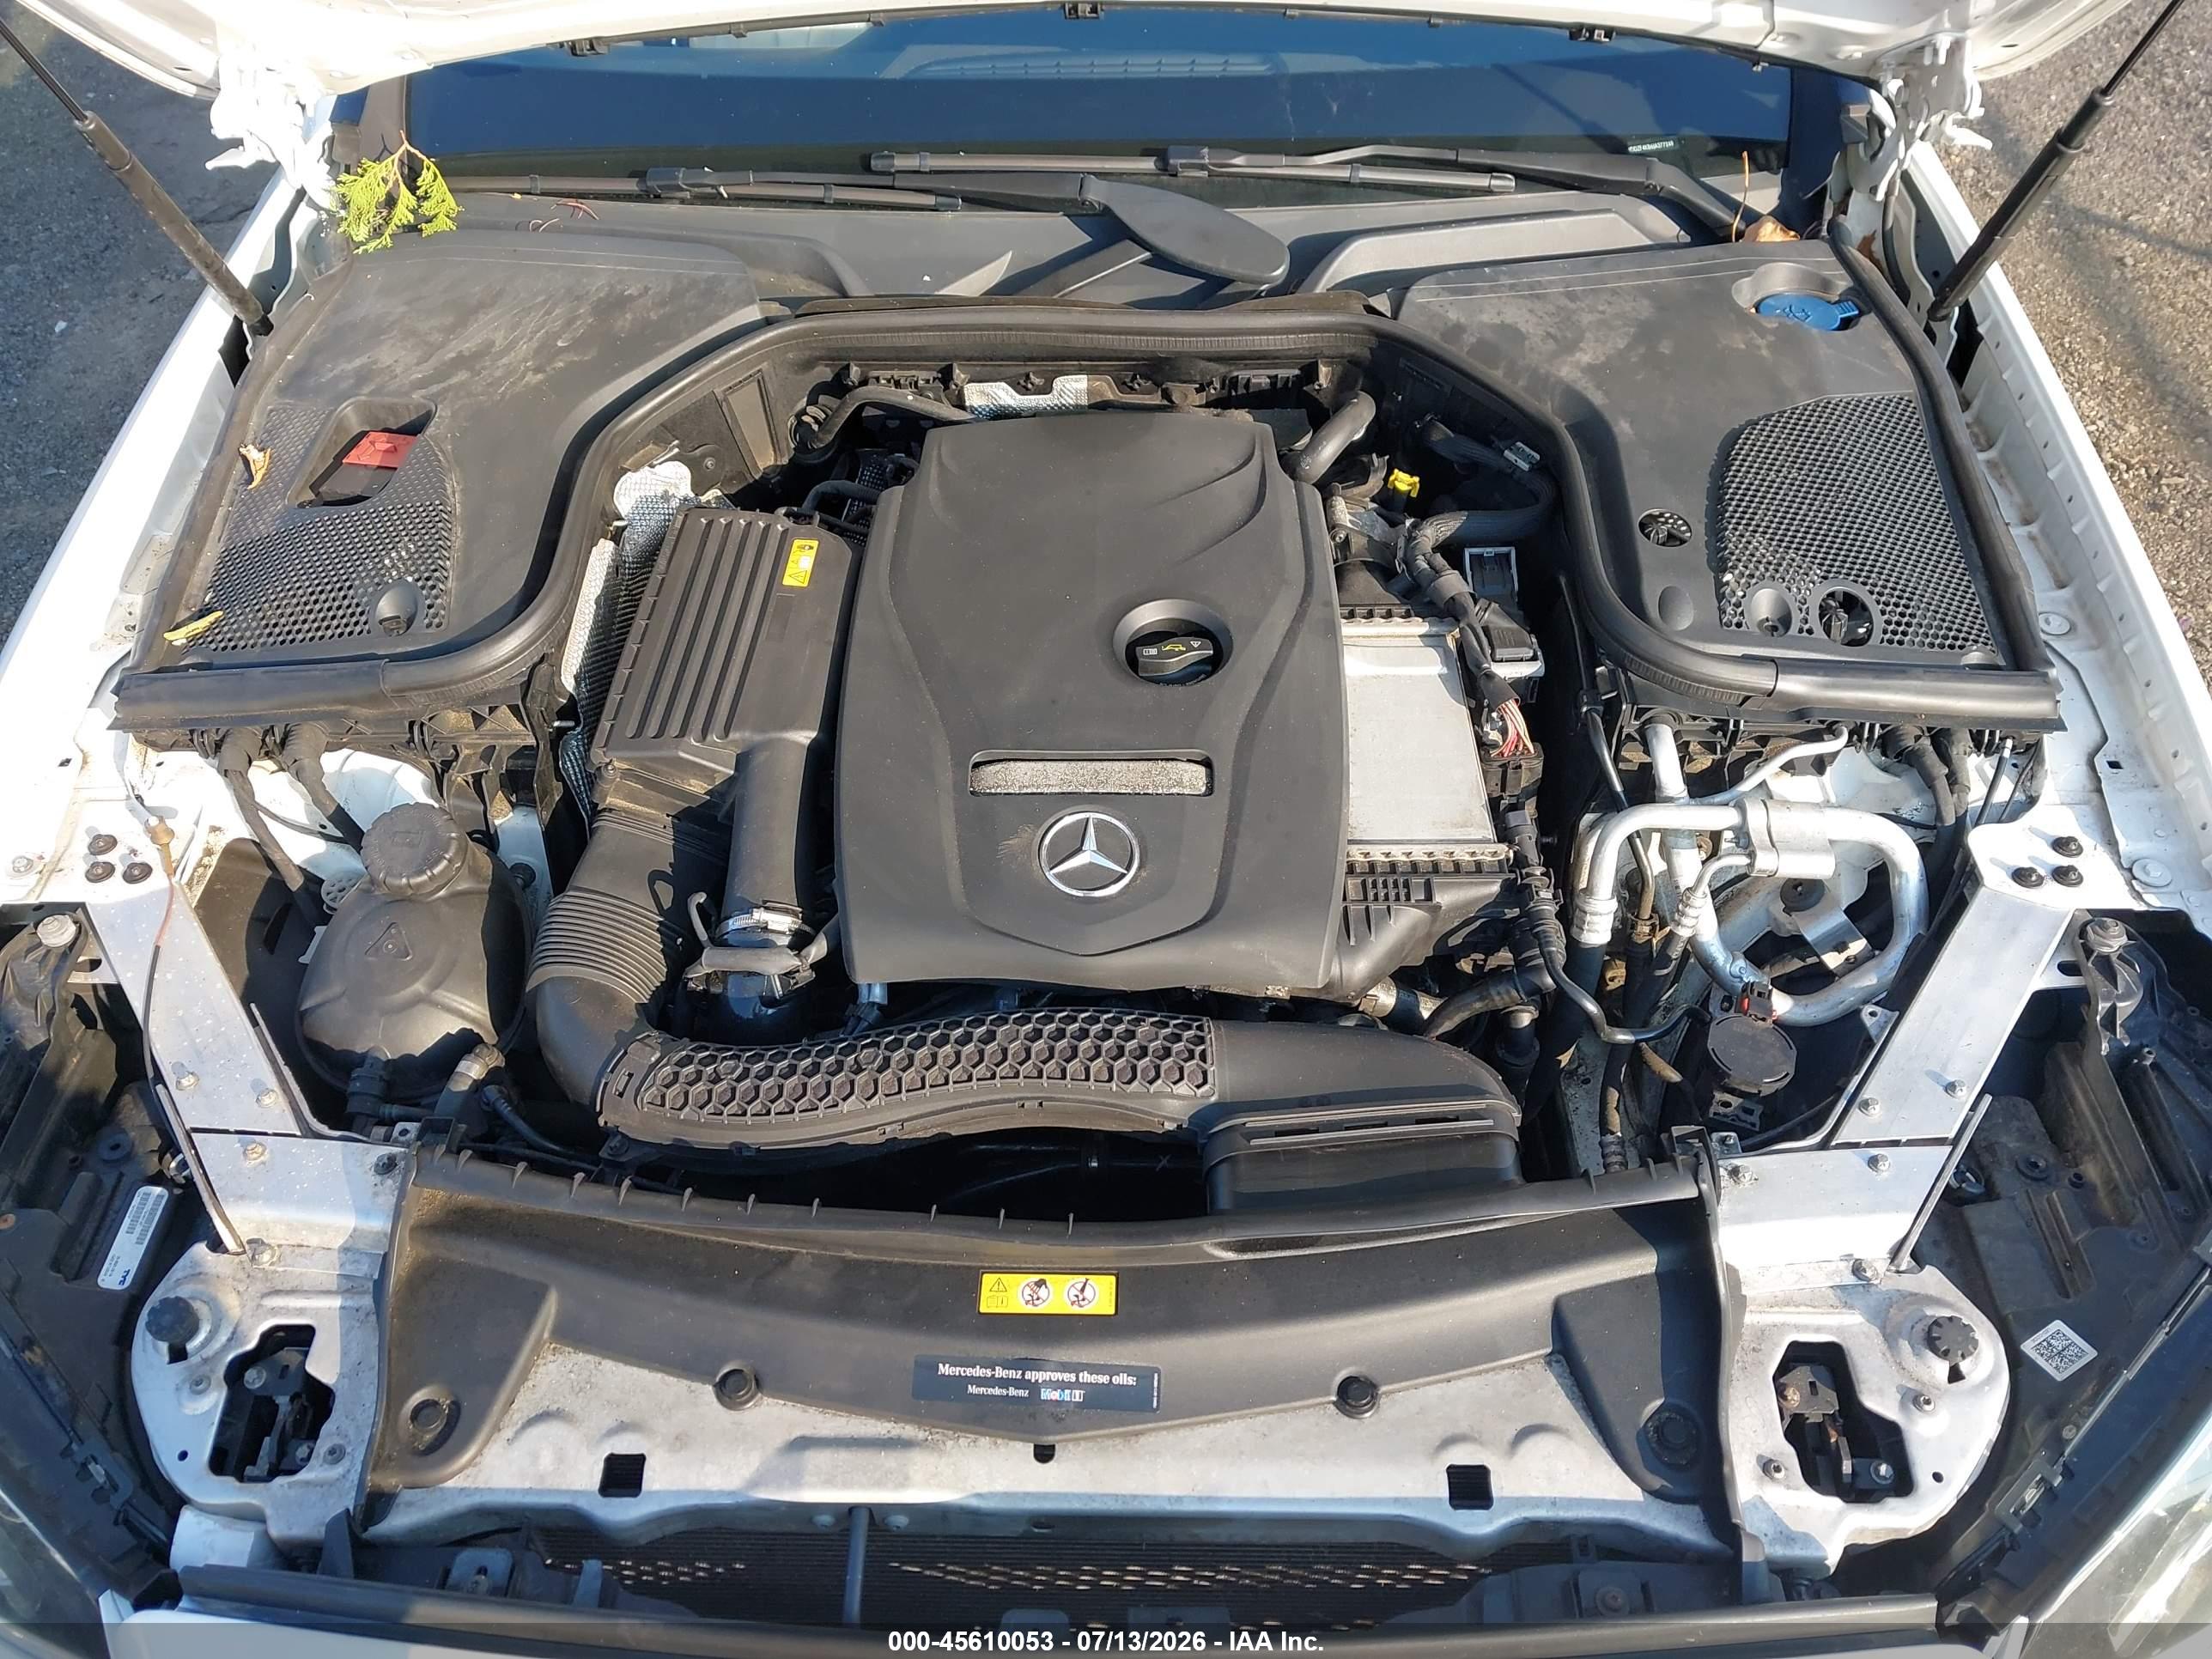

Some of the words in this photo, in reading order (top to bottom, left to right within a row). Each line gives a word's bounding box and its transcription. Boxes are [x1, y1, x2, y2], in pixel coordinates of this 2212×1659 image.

[938, 1363, 1023, 1379] Mercedes-Benz
[1024, 1370, 1076, 1383] approves
[1079, 1370, 1110, 1384] these
[1112, 1372, 1137, 1386] oils:
[967, 1384, 1030, 1398] Mercedes-Benz
